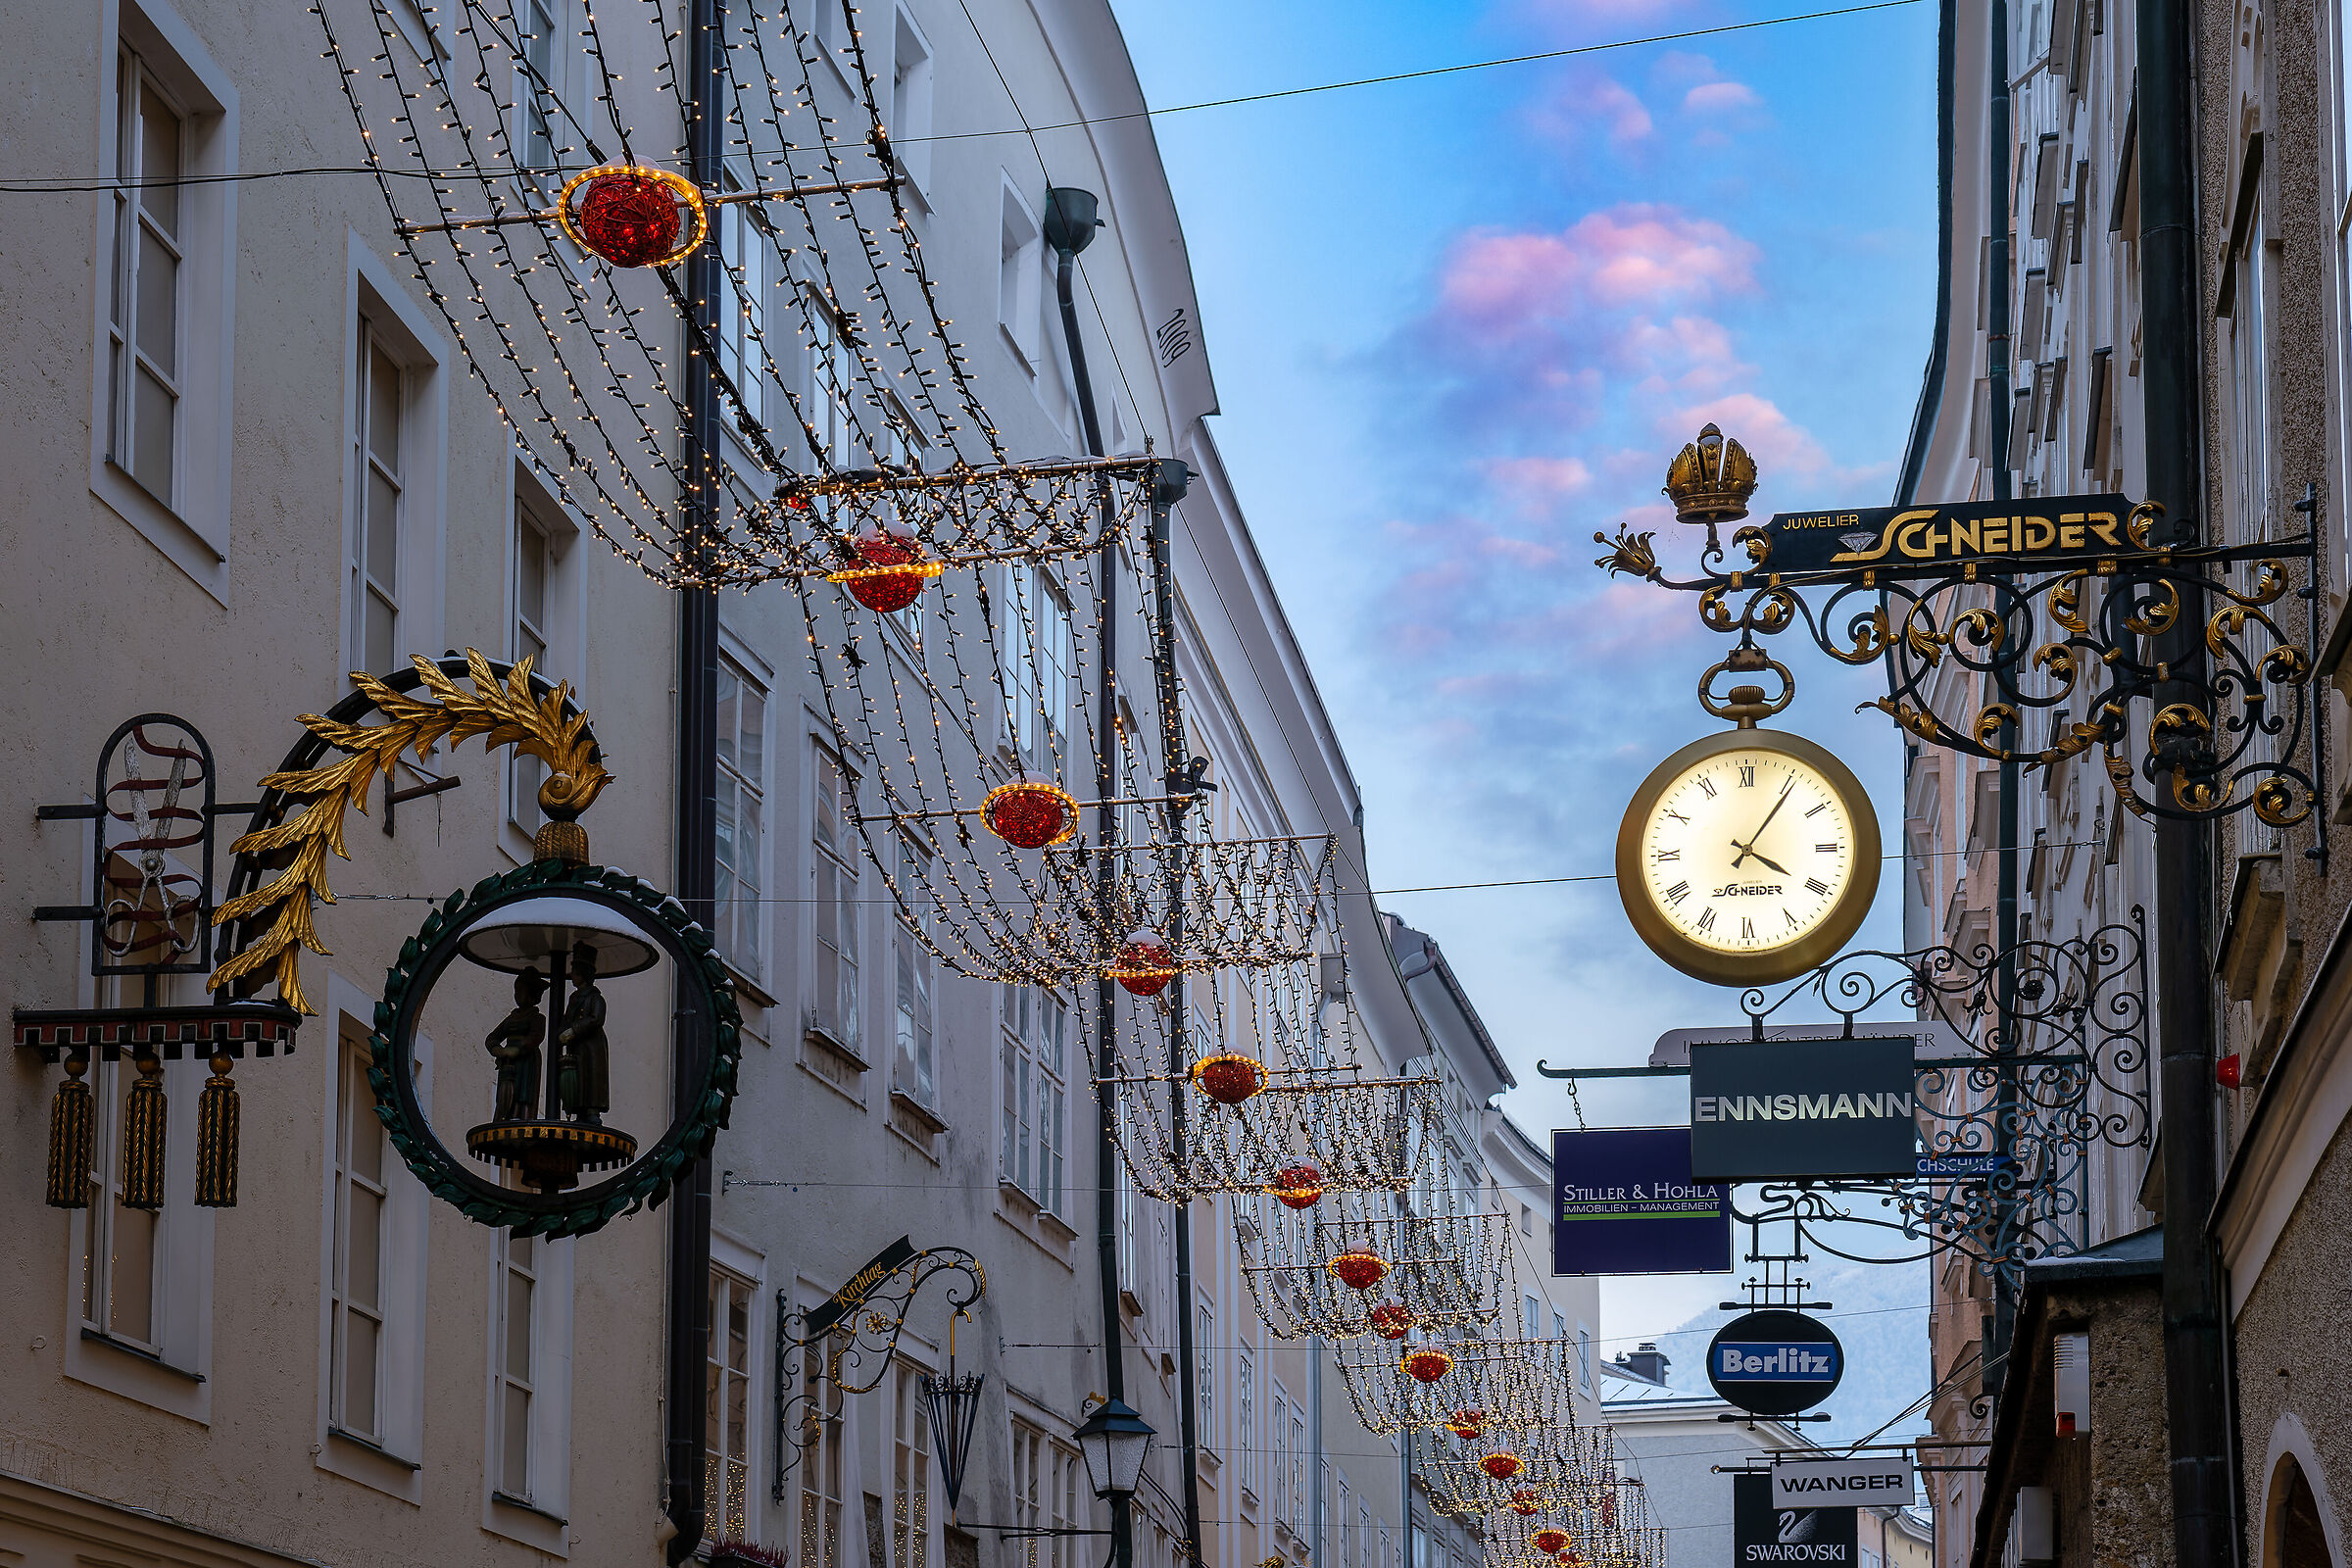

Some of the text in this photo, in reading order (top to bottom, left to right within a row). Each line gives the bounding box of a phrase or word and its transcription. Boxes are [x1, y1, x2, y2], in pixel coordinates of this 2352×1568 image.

[1783, 514, 1859, 530] JUWELIER
[1830, 509, 2123, 563] SCHNEIDER
[1739, 765, 1755, 788] XII
[1697, 777, 1718, 800] XI
[1668, 808, 1690, 825] X
[1804, 803, 1827, 818] II
[1658, 849, 1680, 862] IX
[1815, 842, 1838, 853] III
[1711, 883, 1783, 898] SCHNEIDER
[1782, 907, 1798, 927] V
[1694, 1092, 1912, 1122] ENNSMANN
[1563, 1182, 1719, 1201] STILLER & HOHLA
[1563, 1203, 1629, 1213] IMMOBILIEN
[1640, 1201, 1720, 1212] MANAGEMENT
[833, 1261, 887, 1309] Kirchtag
[1722, 1348, 1829, 1373] Berlitz
[1780, 1474, 1903, 1493] WANGER
[1745, 1544, 1846, 1561] SWAROVSKI
